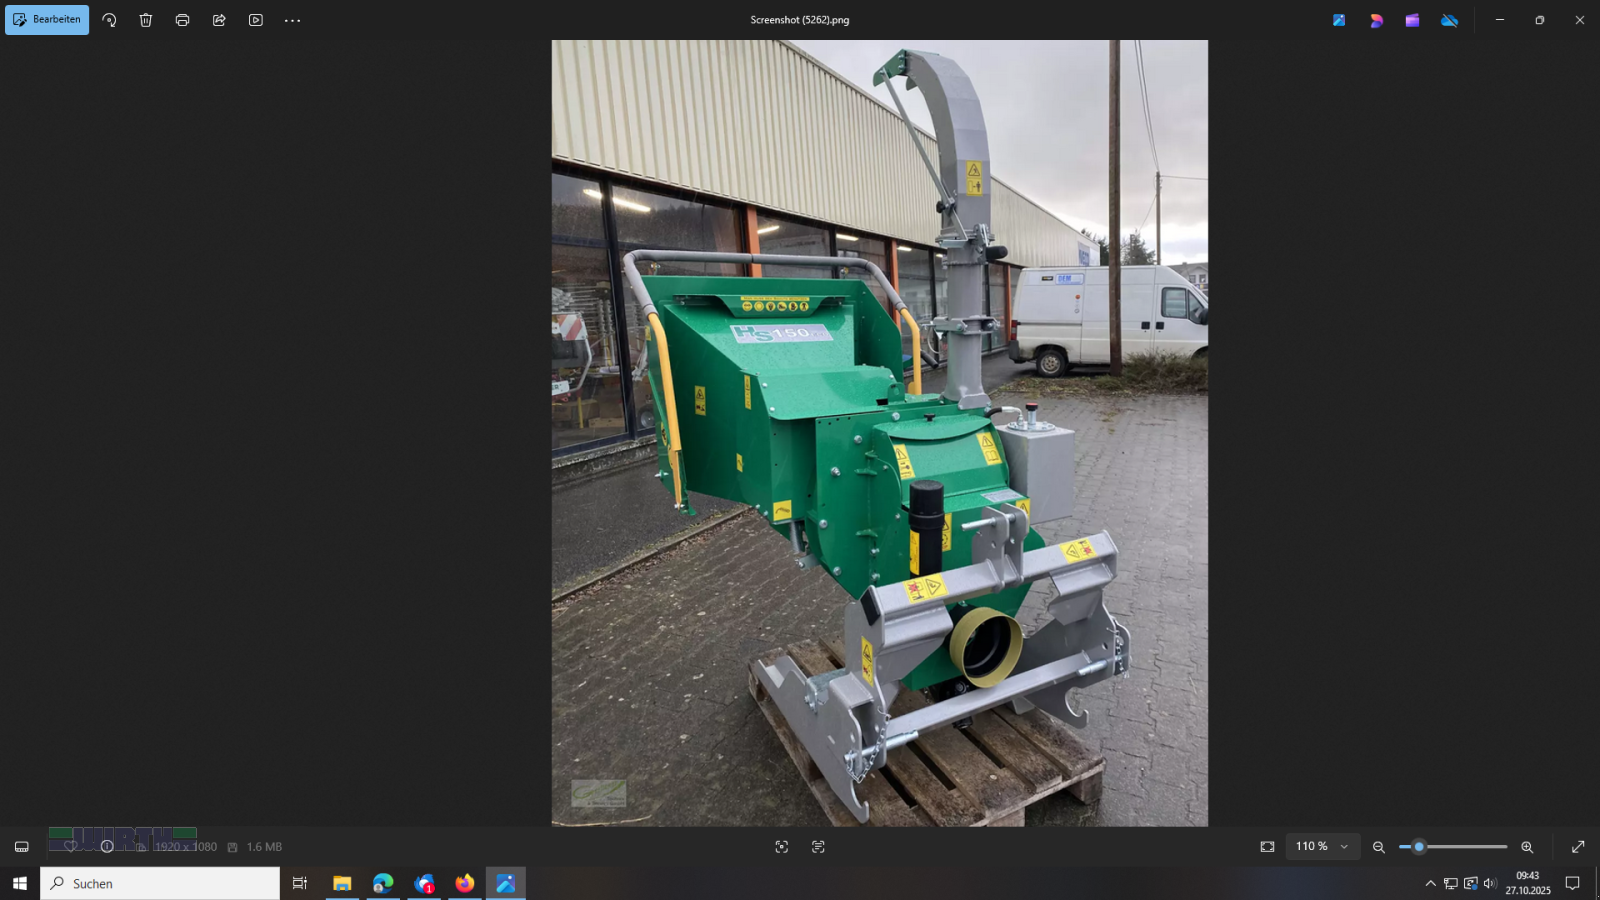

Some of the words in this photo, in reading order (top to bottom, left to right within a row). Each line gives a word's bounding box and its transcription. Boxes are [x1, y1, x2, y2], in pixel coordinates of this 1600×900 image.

[33, 14, 81, 24] Bearbeiten
[750, 15, 800, 25] Screenshot
[802, 15, 850, 27] (5262).png
[155, 842, 181, 852] 1920
[182, 844, 190, 852] x
[192, 842, 218, 852] 1080
[247, 842, 263, 852] 1.6
[265, 842, 283, 852] MB
[1296, 841, 1316, 851] 110
[1317, 841, 1329, 851] %
[1516, 871, 1540, 880] 09:43
[73, 878, 113, 890] Suchen
[426, 885, 432, 893] 1
[1505, 886, 1552, 895] 27.10.2025
